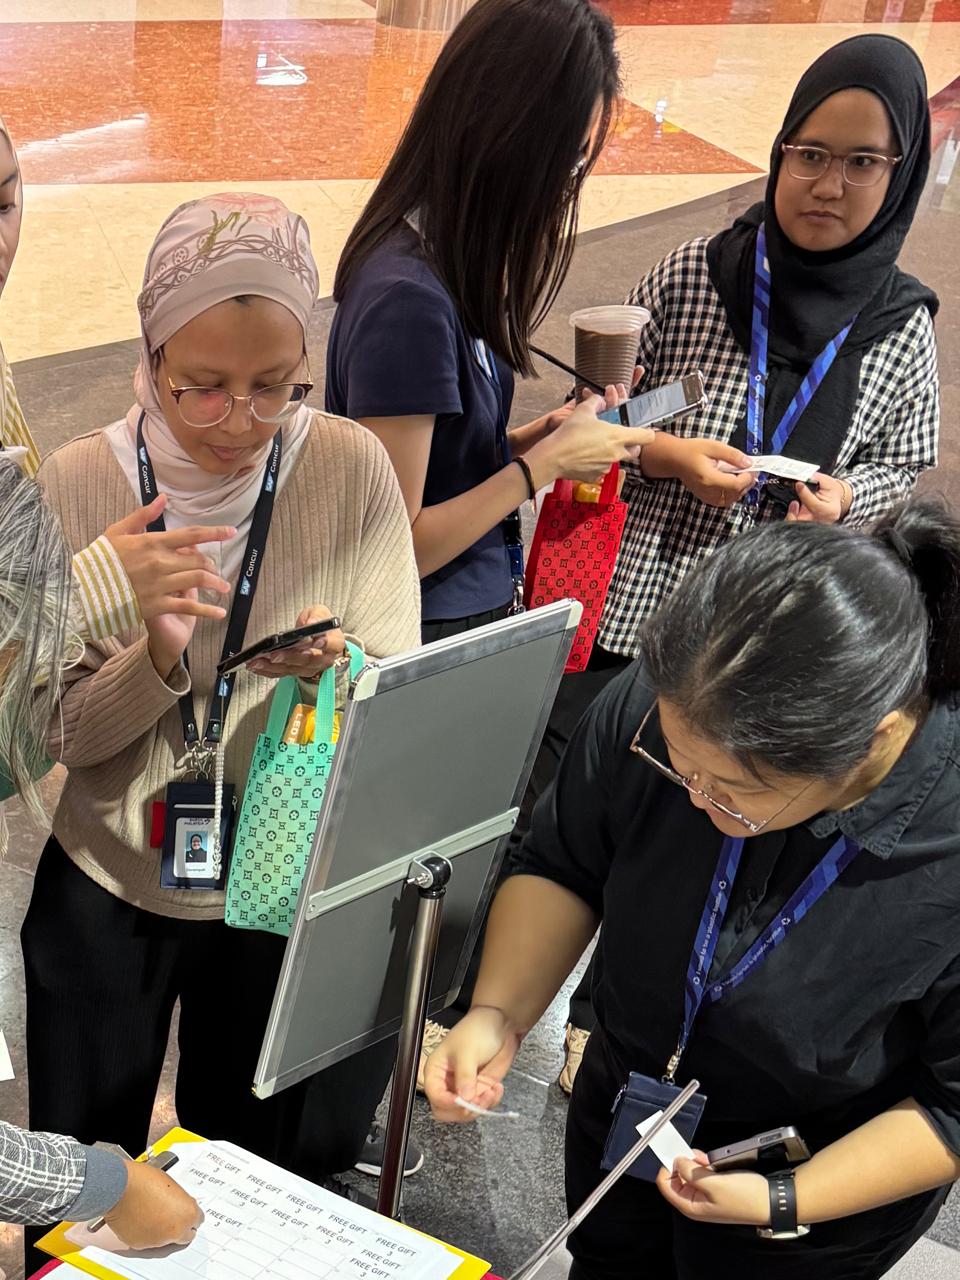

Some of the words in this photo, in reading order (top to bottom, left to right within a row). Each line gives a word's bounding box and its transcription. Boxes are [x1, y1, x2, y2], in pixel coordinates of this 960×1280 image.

[266, 443, 283, 473] Concur
[140, 464, 152, 494] Concur
[243, 548, 261, 577] Concur
[290, 712, 302, 735] LED
[705, 912, 717, 933] plastic
[206, 1152, 226, 1166] FREE
[224, 1162, 241, 1175] GIFT
[189, 1167, 208, 1180] FREE
[208, 1175, 224, 1187] GIFT
[246, 1172, 266, 1187] FREE
[265, 1182, 282, 1195] GIFT
[230, 1187, 249, 1201] FREE
[249, 1195, 267, 1209] GIFT
[285, 1192, 306, 1207] FREE
[305, 1202, 323, 1215] GIFT
[206, 1207, 224, 1220] FREE
[224, 1216, 242, 1228] GIFT
[271, 1207, 290, 1221] FREE
[290, 1216, 308, 1229] GIFT
[328, 1213, 348, 1227] FREE
[348, 1222, 367, 1236] GIFT
[316, 1224, 335, 1238] FREE
[335, 1234, 353, 1247] GIFT
[375, 1234, 397, 1251] FREE
[396, 1244, 416, 1258] GIFT
[349, 1256, 370, 1271] FREE
[370, 1266, 389, 1279] GIFT
[361, 1247, 382, 1262] FREE
[382, 1257, 400, 1270] GIFT
[359, 1270, 366, 1278] 3
